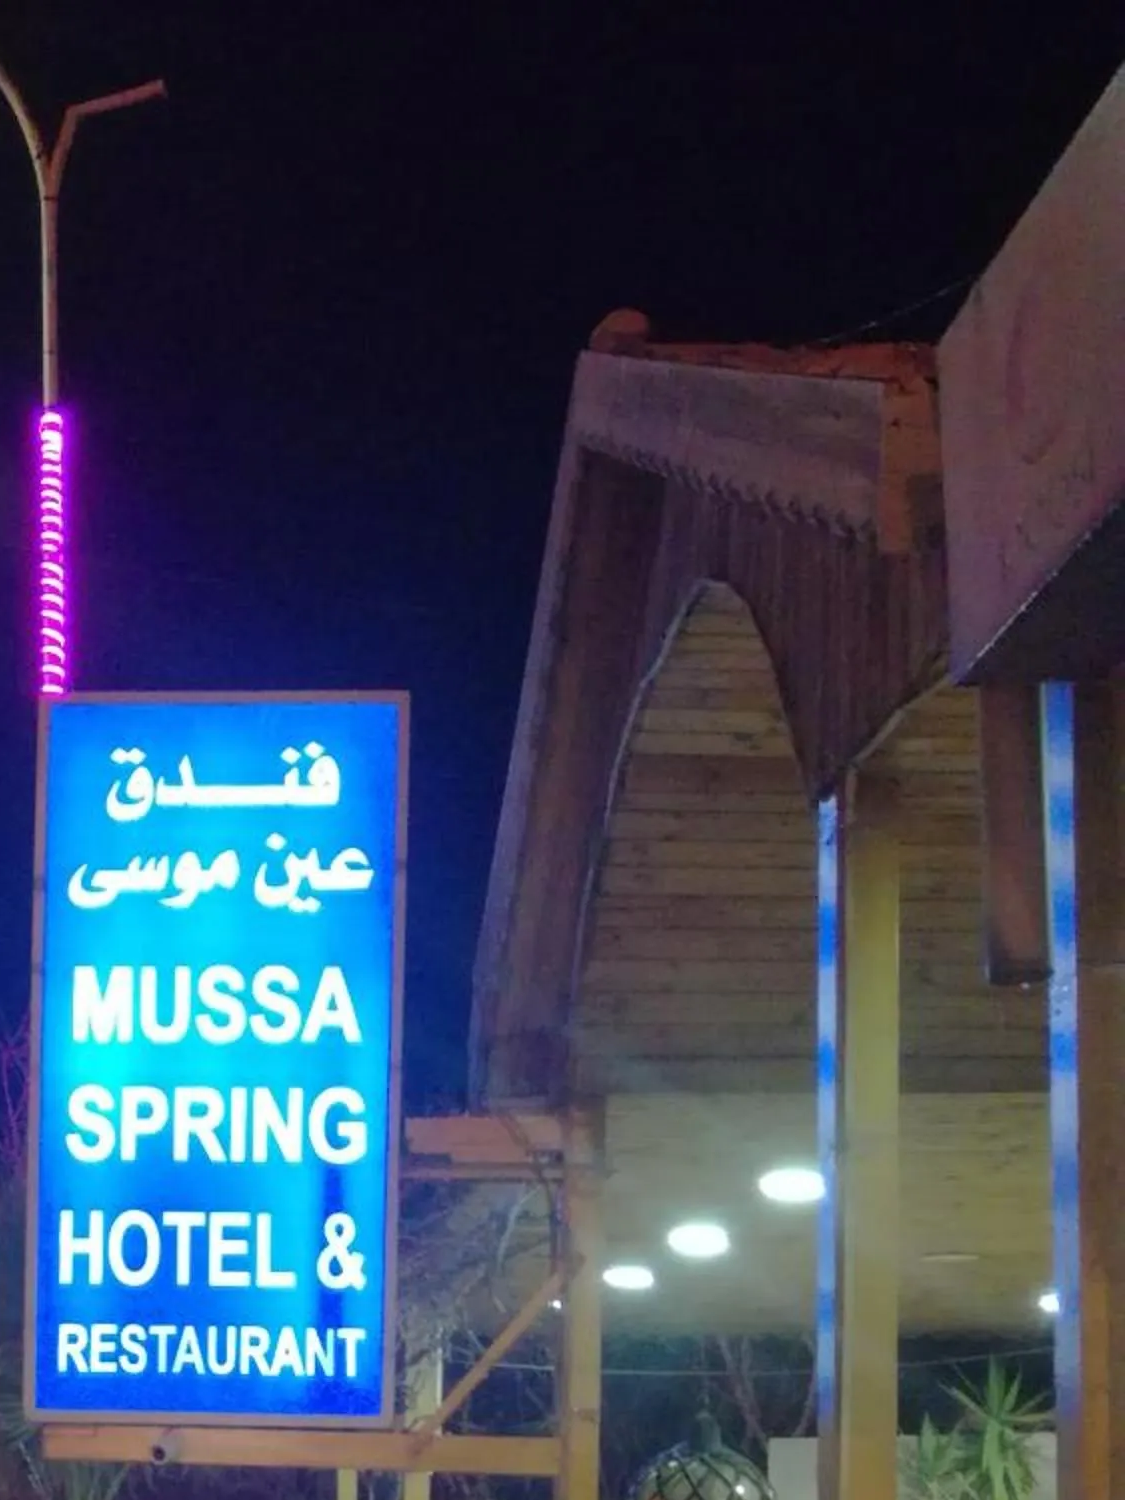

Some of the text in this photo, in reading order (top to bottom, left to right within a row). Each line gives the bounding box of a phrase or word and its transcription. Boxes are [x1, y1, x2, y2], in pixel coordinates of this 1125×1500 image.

[106, 741, 341, 822] فندق
[68, 832, 375, 913] عين موسى
[72, 965, 361, 1044] MUSSA
[66, 1084, 367, 1164] SPRING
[58, 1210, 366, 1290] HOTEL &
[58, 1323, 365, 1377] RESTAURANT
